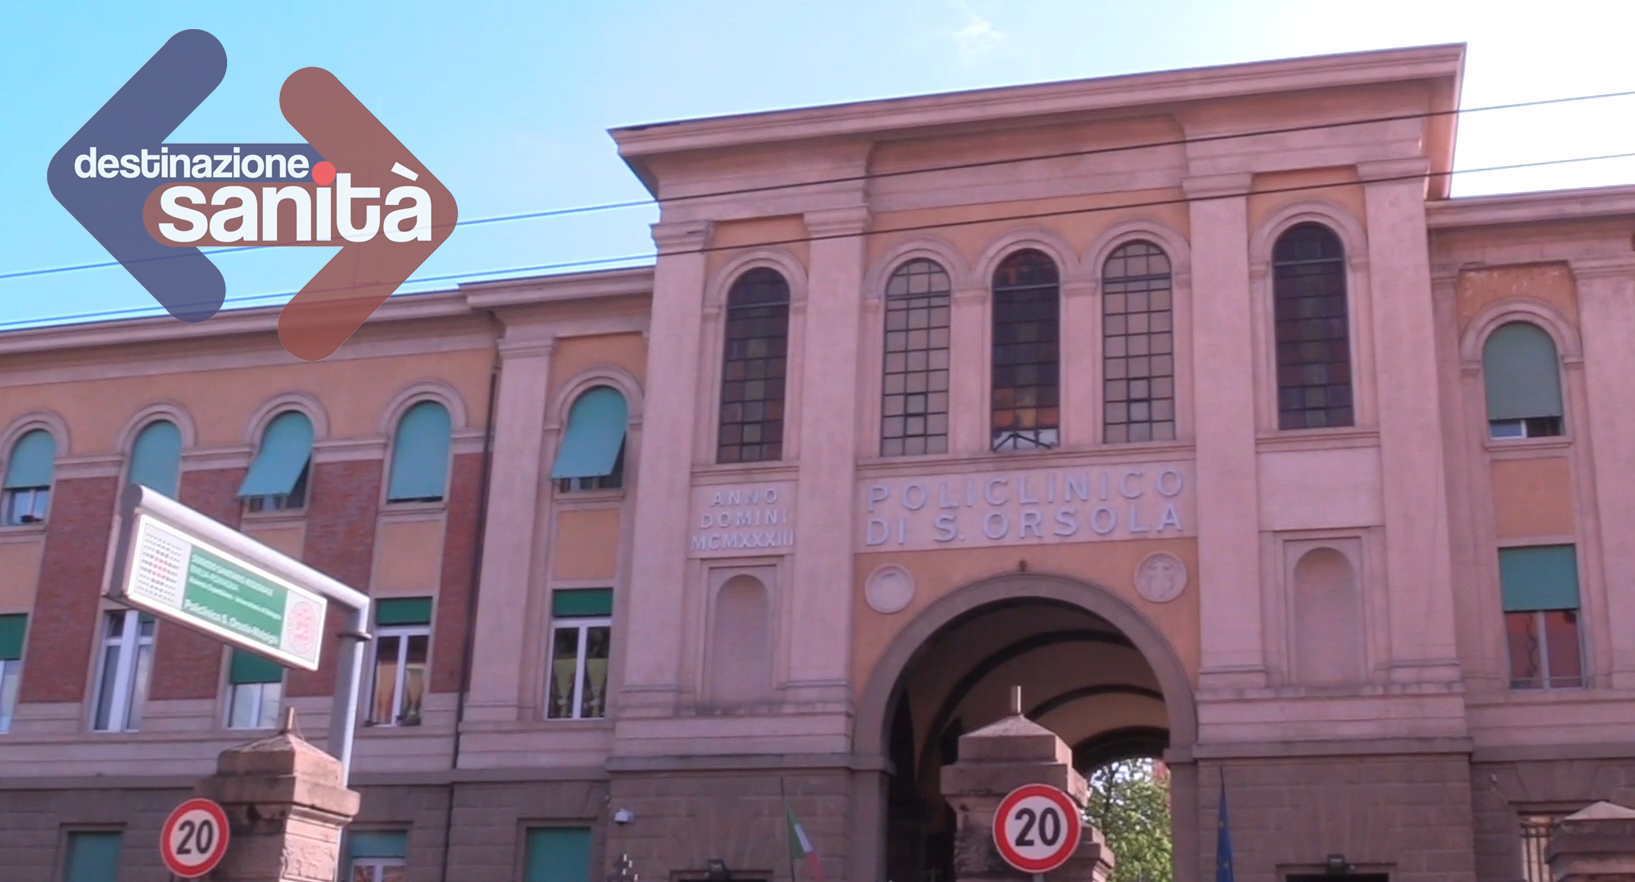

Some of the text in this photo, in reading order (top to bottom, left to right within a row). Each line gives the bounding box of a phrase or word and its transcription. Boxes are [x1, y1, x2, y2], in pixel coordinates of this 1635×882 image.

[710, 489, 777, 508] ANNO
[868, 469, 1184, 513] POLICLINICO
[700, 510, 788, 530] DOMINI
[866, 502, 1184, 547] DI S. ORSOLA
[692, 531, 794, 551] MCMXXXIII
[176, 819, 214, 856] 20
[1014, 807, 1061, 847] 20
